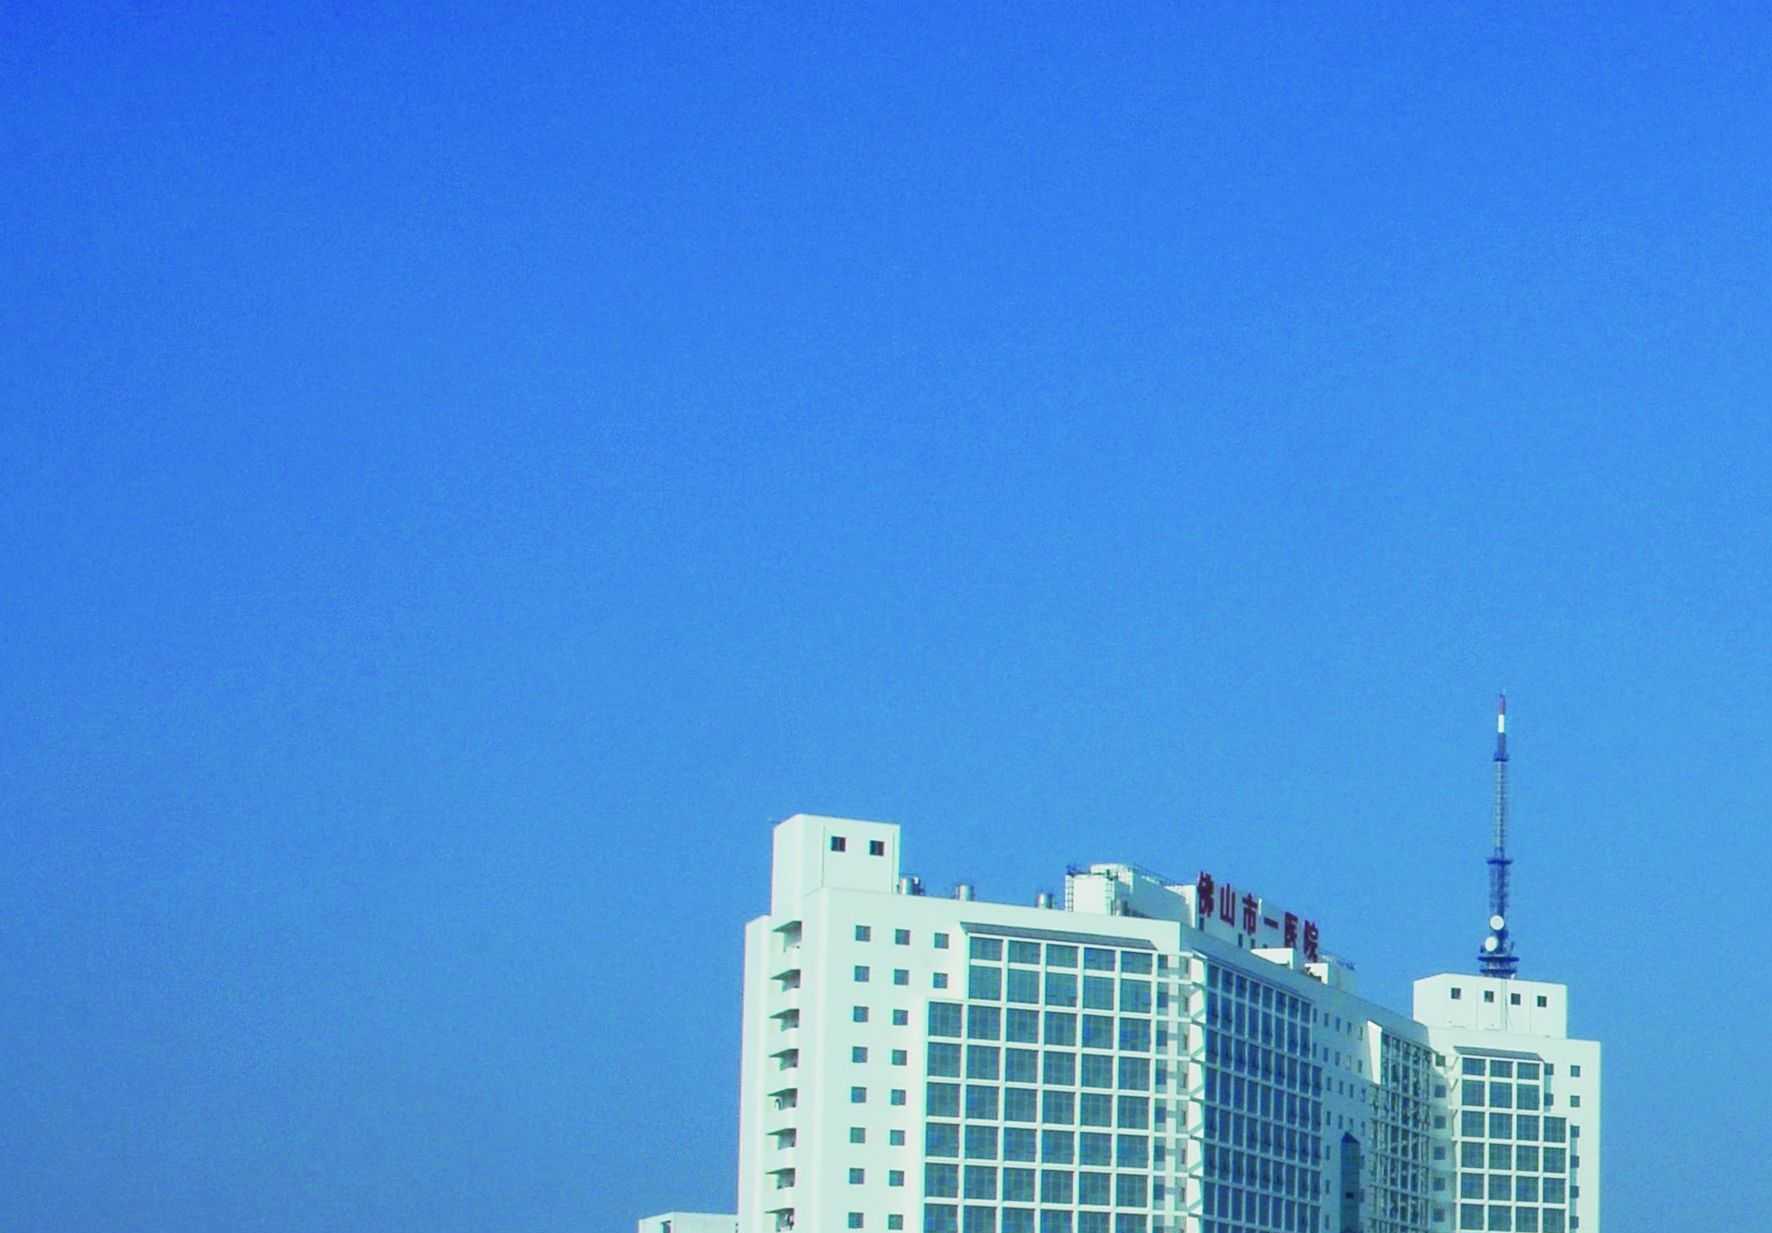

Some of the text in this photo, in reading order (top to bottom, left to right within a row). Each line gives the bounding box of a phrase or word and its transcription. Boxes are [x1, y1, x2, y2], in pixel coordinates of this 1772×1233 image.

[1197, 871, 1319, 963] 佛山市一医院
